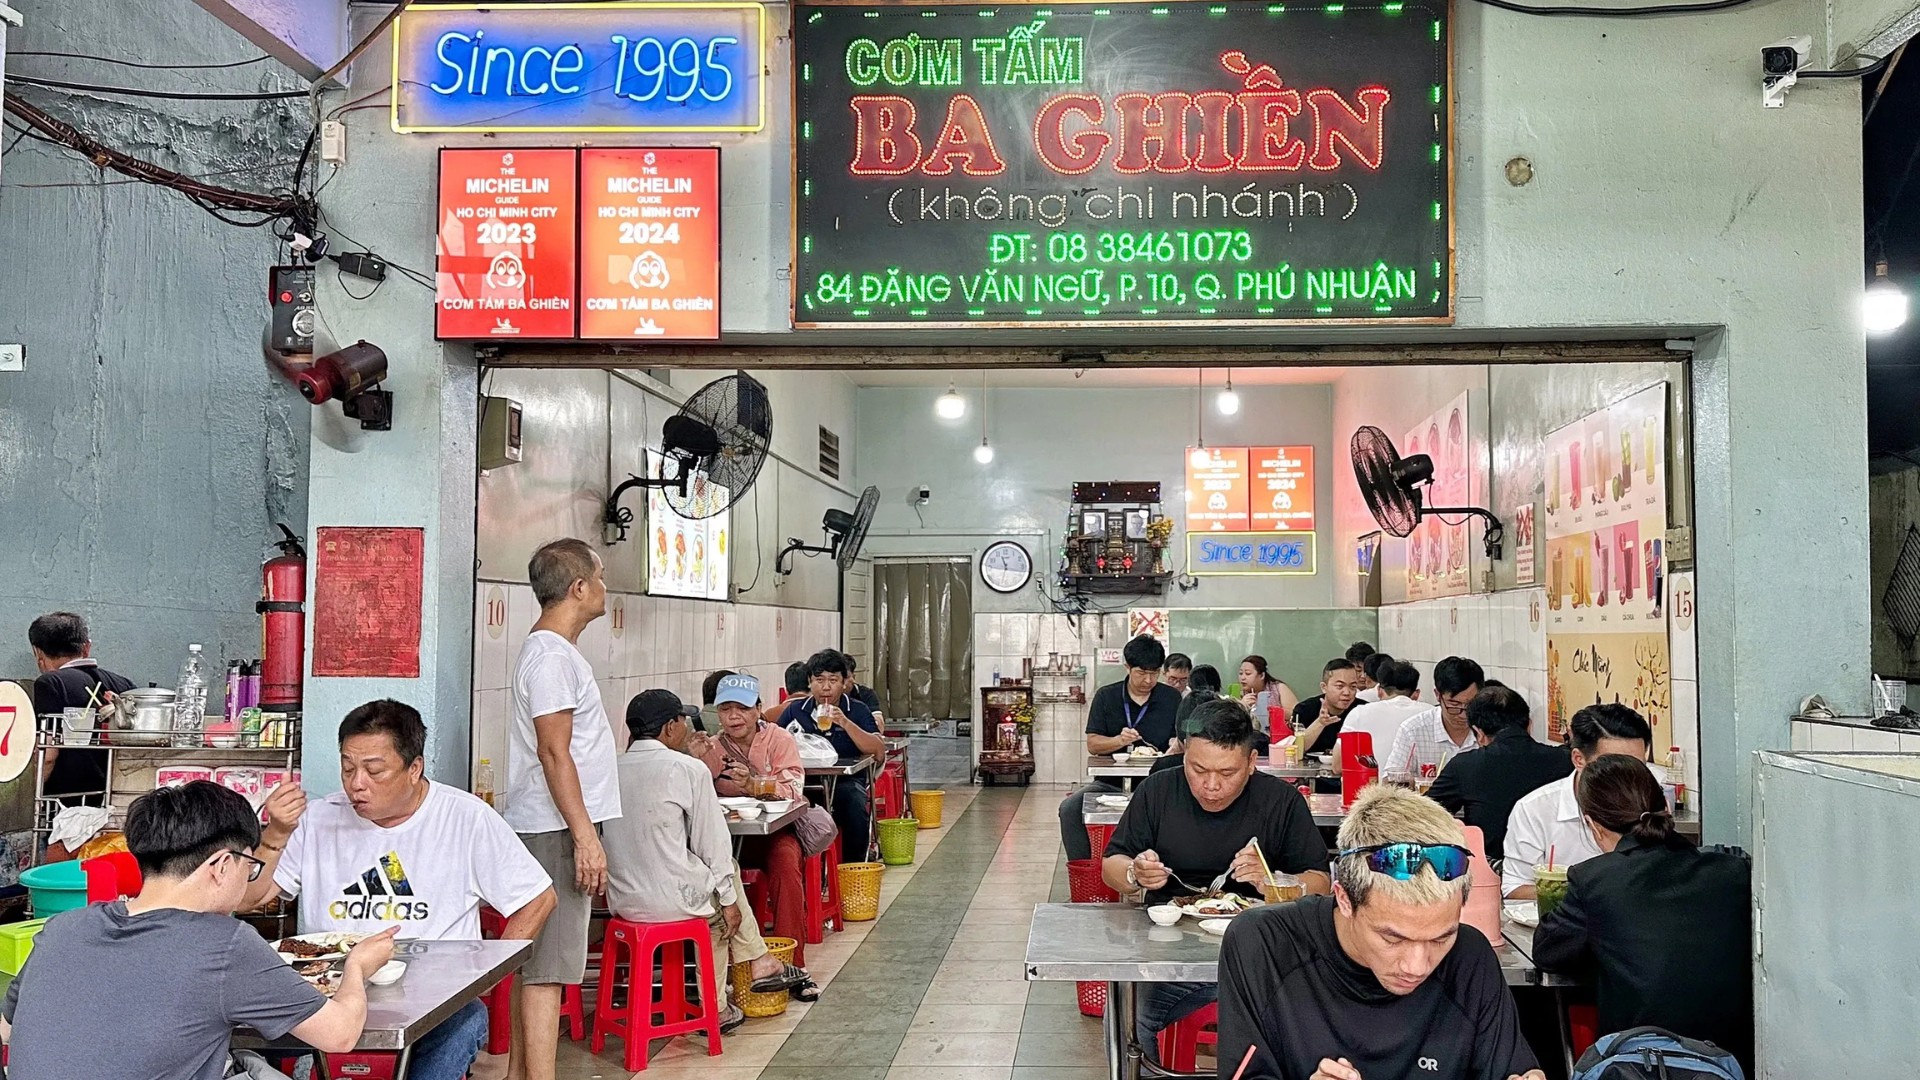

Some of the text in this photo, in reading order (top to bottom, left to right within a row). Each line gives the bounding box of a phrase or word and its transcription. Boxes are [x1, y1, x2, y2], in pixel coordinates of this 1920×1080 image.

[846, 19, 1084, 86] CƠM TẤM
[431, 29, 738, 102] Since 1995
[849, 50, 1391, 176] BA GHIỀN
[500, 167, 516, 175] THE
[642, 166, 658, 175] THE
[465, 178, 550, 193] MICHELIN
[607, 177, 692, 193] MICHELIN
[494, 196, 519, 204] GUIDE
[636, 195, 662, 204] GUIDE
[1084, 183, 1153, 220] chi
[456, 207, 558, 218] HO CHI MINH CITY
[598, 206, 701, 218] HO CHI MINH CITY
[476, 222, 537, 244] 2023
[618, 221, 681, 244] 2024
[989, 230, 1253, 264] ĐT: 08 38461073
[816, 273, 854, 303] 84
[859, 268, 951, 307] ĐẶNG
[958, 268, 1024, 303] VĂN
[1194, 272, 1227, 300] Q.
[1237, 262, 1296, 301] PHÚ
[1305, 261, 1416, 304] NHUẬN
[443, 298, 474, 310] CƠM
[507, 298, 527, 310] BA
[650, 298, 671, 310] BA
[1199, 539, 1304, 567] Since 1995
[487, 599, 505, 626] 10
[1529, 601, 1540, 622] 16
[1674, 590, 1692, 618] 15
[612, 607, 624, 629] 11
[717, 613, 725, 630] 12
[1450, 607, 1458, 625] 17
[1101, 650, 1119, 660] WC
[0, 706, 17, 757] 7
[328, 895, 429, 921] adidas
[1417, 1056, 1439, 1071] OR
